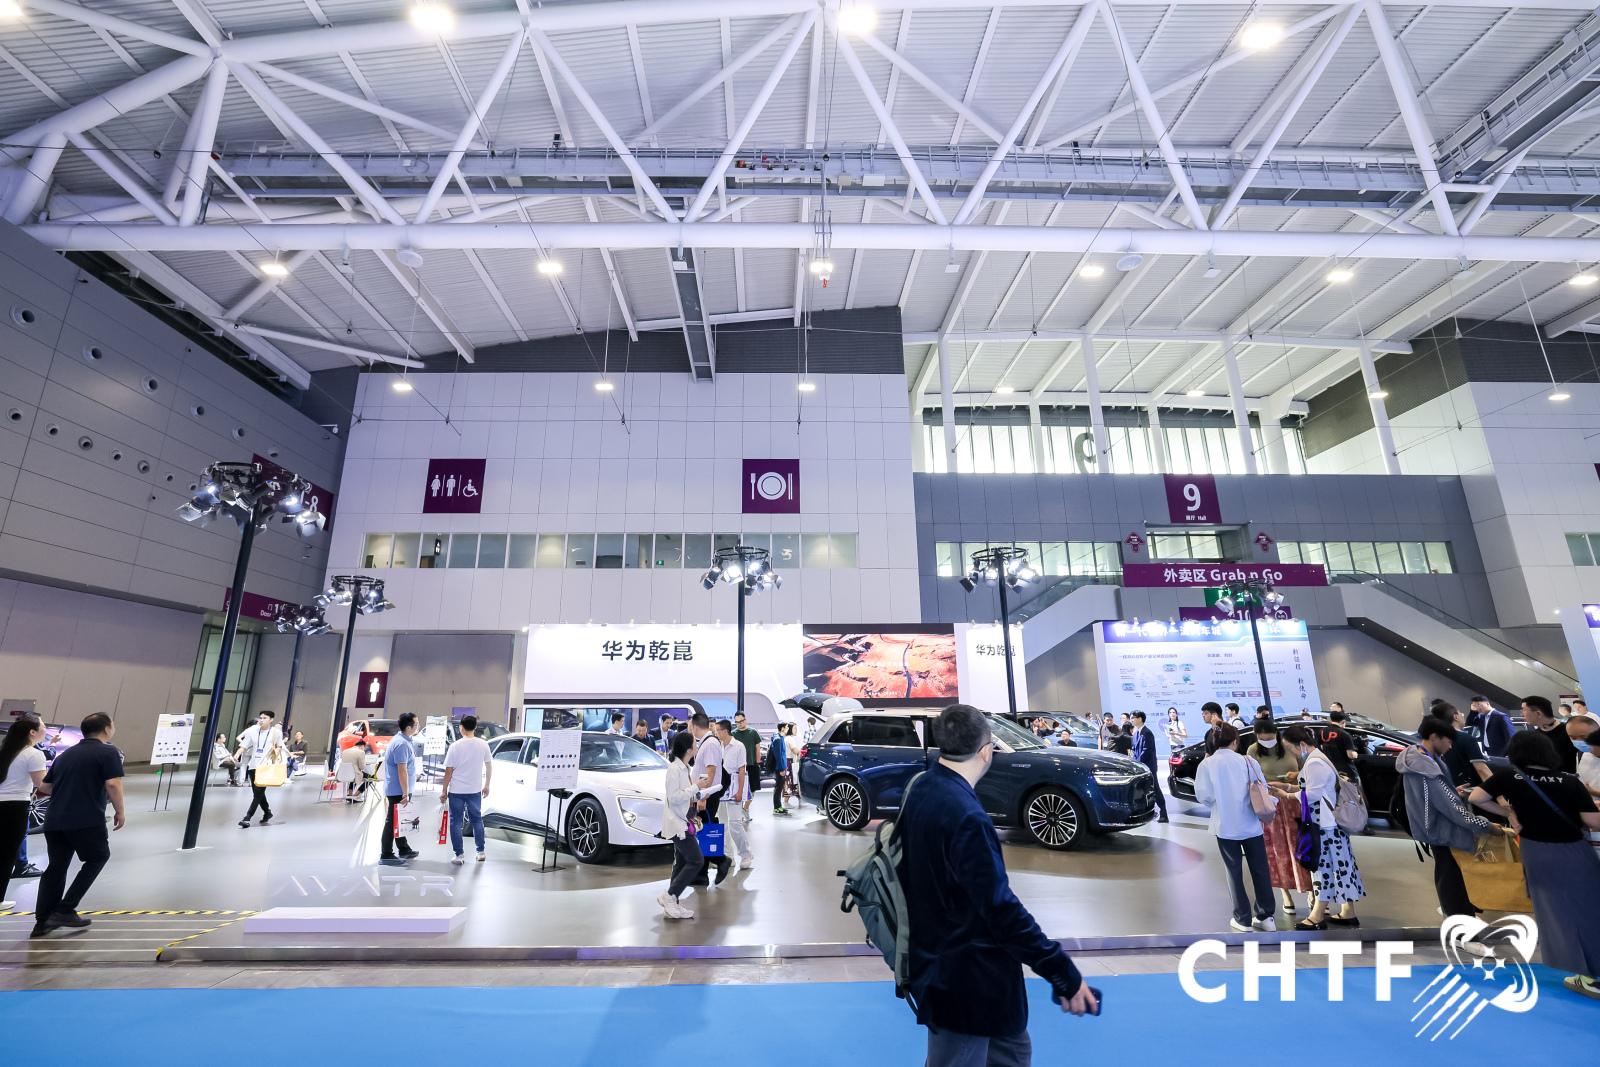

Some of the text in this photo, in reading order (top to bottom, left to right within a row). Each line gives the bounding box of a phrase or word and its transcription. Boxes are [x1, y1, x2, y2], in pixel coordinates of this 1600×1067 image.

[1183, 484, 1201, 512] 9
[1164, 568, 1208, 583] 外卖区
[1210, 568, 1246, 581] Grab
[1262, 568, 1283, 581] Go
[260, 609, 272, 618] Door
[601, 640, 693, 661] 华为乾崑
[1513, 773, 1564, 784] GLAXY
[270, 875, 455, 897] AVATR
